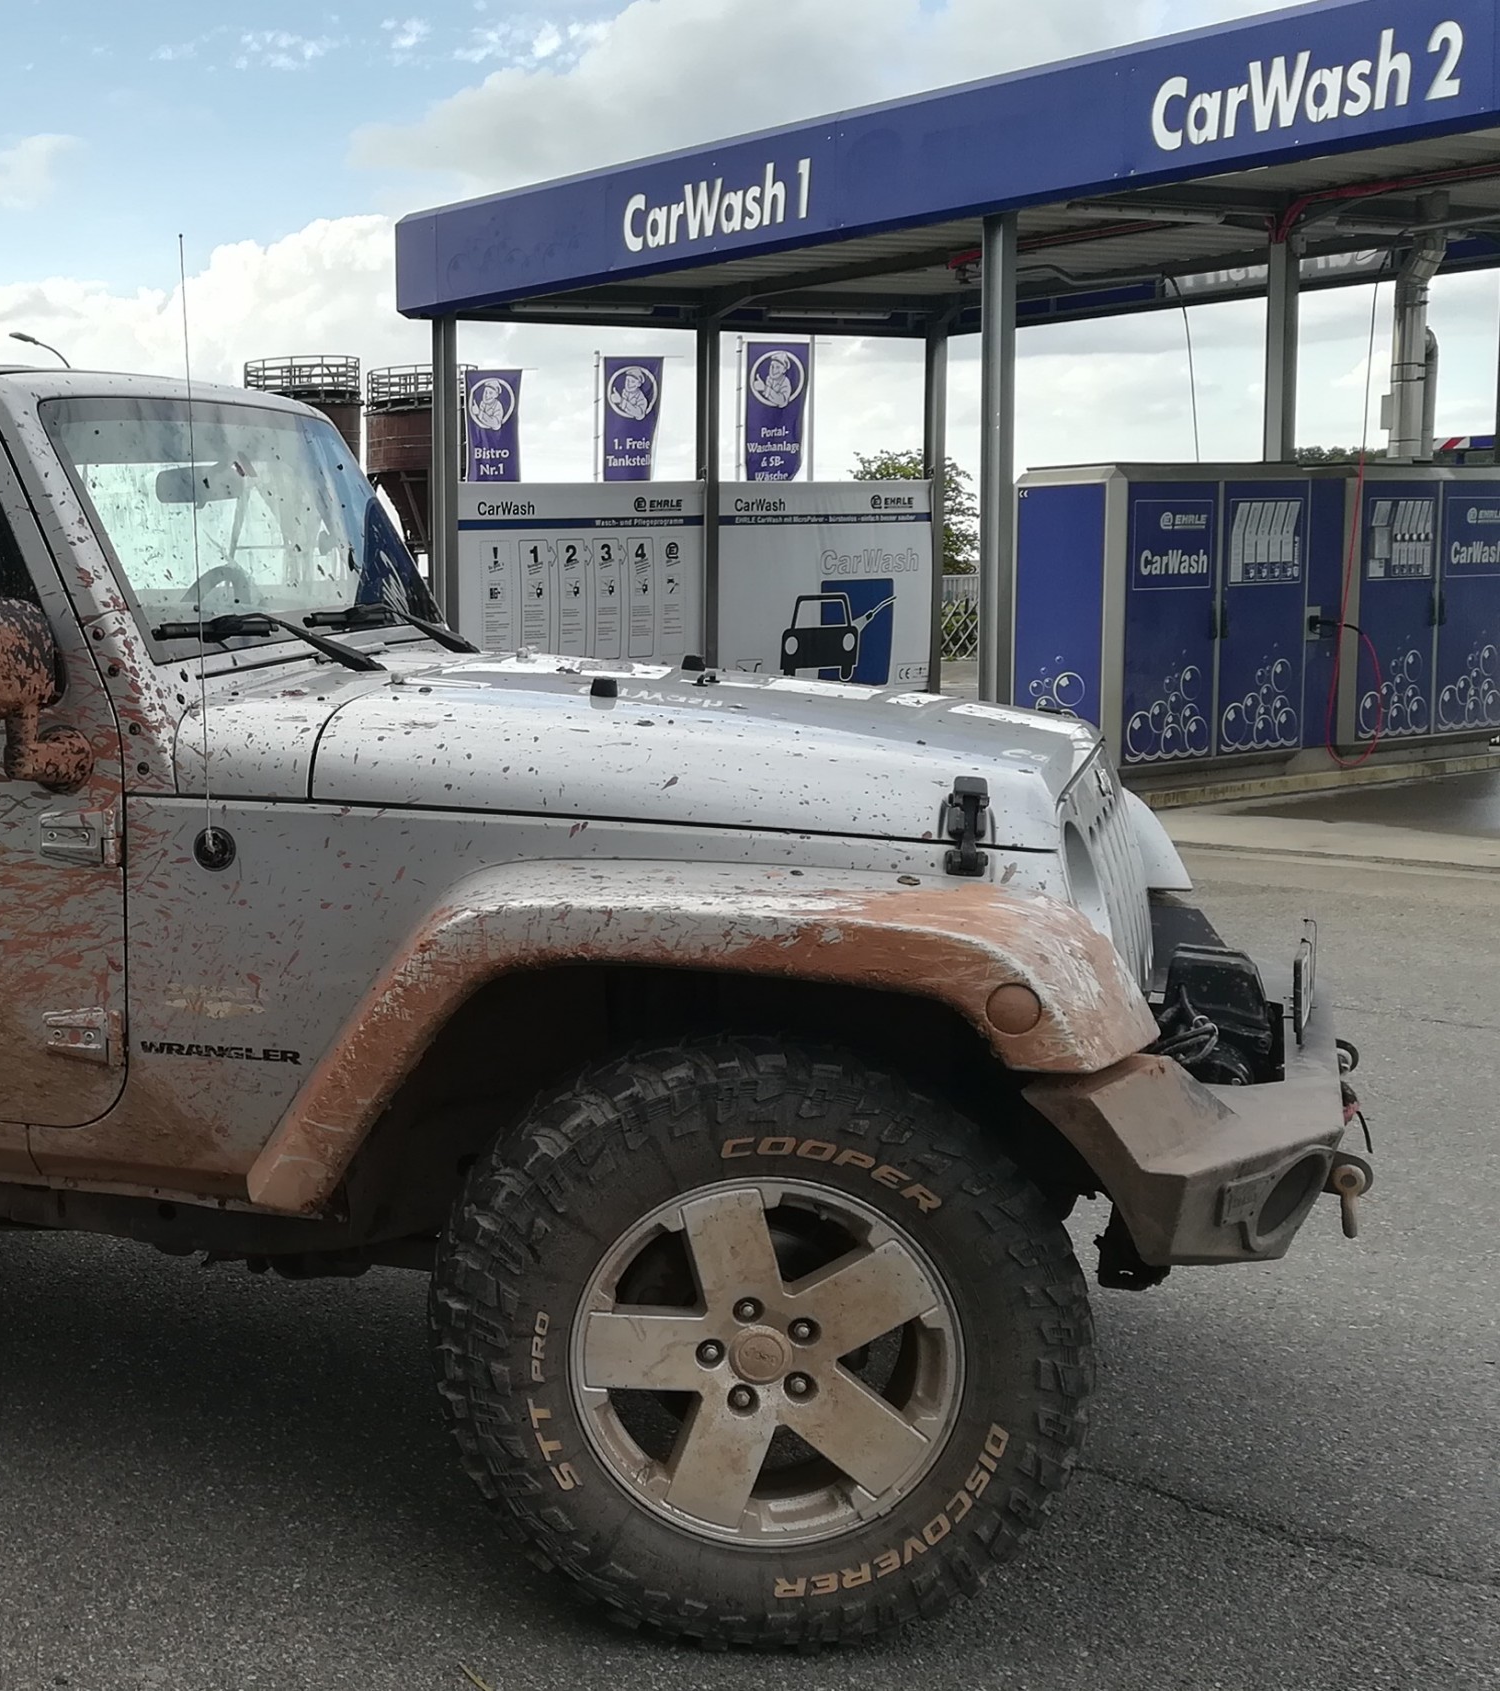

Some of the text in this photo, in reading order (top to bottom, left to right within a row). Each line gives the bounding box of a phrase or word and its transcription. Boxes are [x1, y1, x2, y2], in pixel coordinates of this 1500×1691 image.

[1152, 21, 1464, 150] CarWash 2
[623, 157, 811, 252] CarWash 1
[761, 425, 789, 438] Portal-
[613, 437, 651, 450] 1. Freie
[474, 447, 510, 459] Bistro
[479, 463, 504, 476] Nr.1
[477, 501, 535, 516] CarWash
[649, 499, 683, 509] EHRLE
[734, 498, 786, 512] CarWash
[884, 497, 913, 506] EHRLE
[1174, 514, 1208, 525] EHRLE
[1479, 509, 1500, 519] EHRL
[529, 546, 540, 563] 1
[565, 545, 578, 564] 2
[600, 543, 613, 562] 3
[635, 543, 647, 560] 4
[819, 548, 920, 575] CarWash
[1140, 549, 1208, 575] CarWash
[140, 1040, 302, 1065] WRANGLER
[719, 1135, 944, 1214] COOPER
[527, 1311, 584, 1492] STT PRO
[773, 1423, 1010, 1599] DISCOVERER
